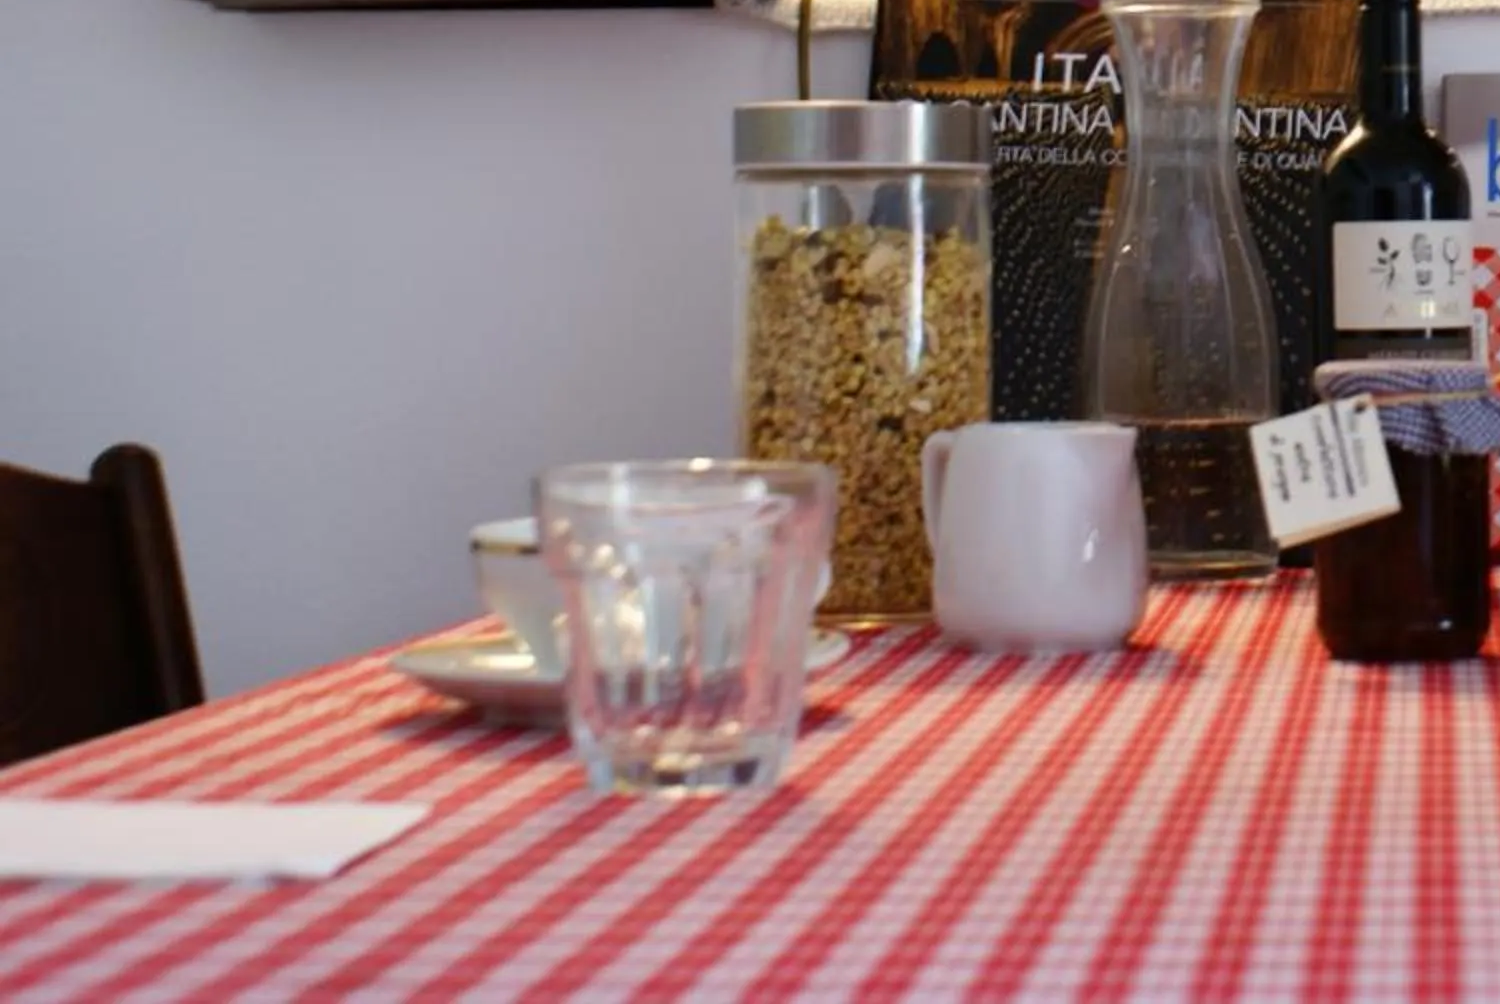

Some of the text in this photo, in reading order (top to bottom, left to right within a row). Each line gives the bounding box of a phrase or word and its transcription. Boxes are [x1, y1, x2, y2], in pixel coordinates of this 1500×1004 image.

[1032, 51, 1123, 94] ITA
[952, 100, 1348, 141] NTINA NTINA
[1037, 146, 1097, 167] DELLA
